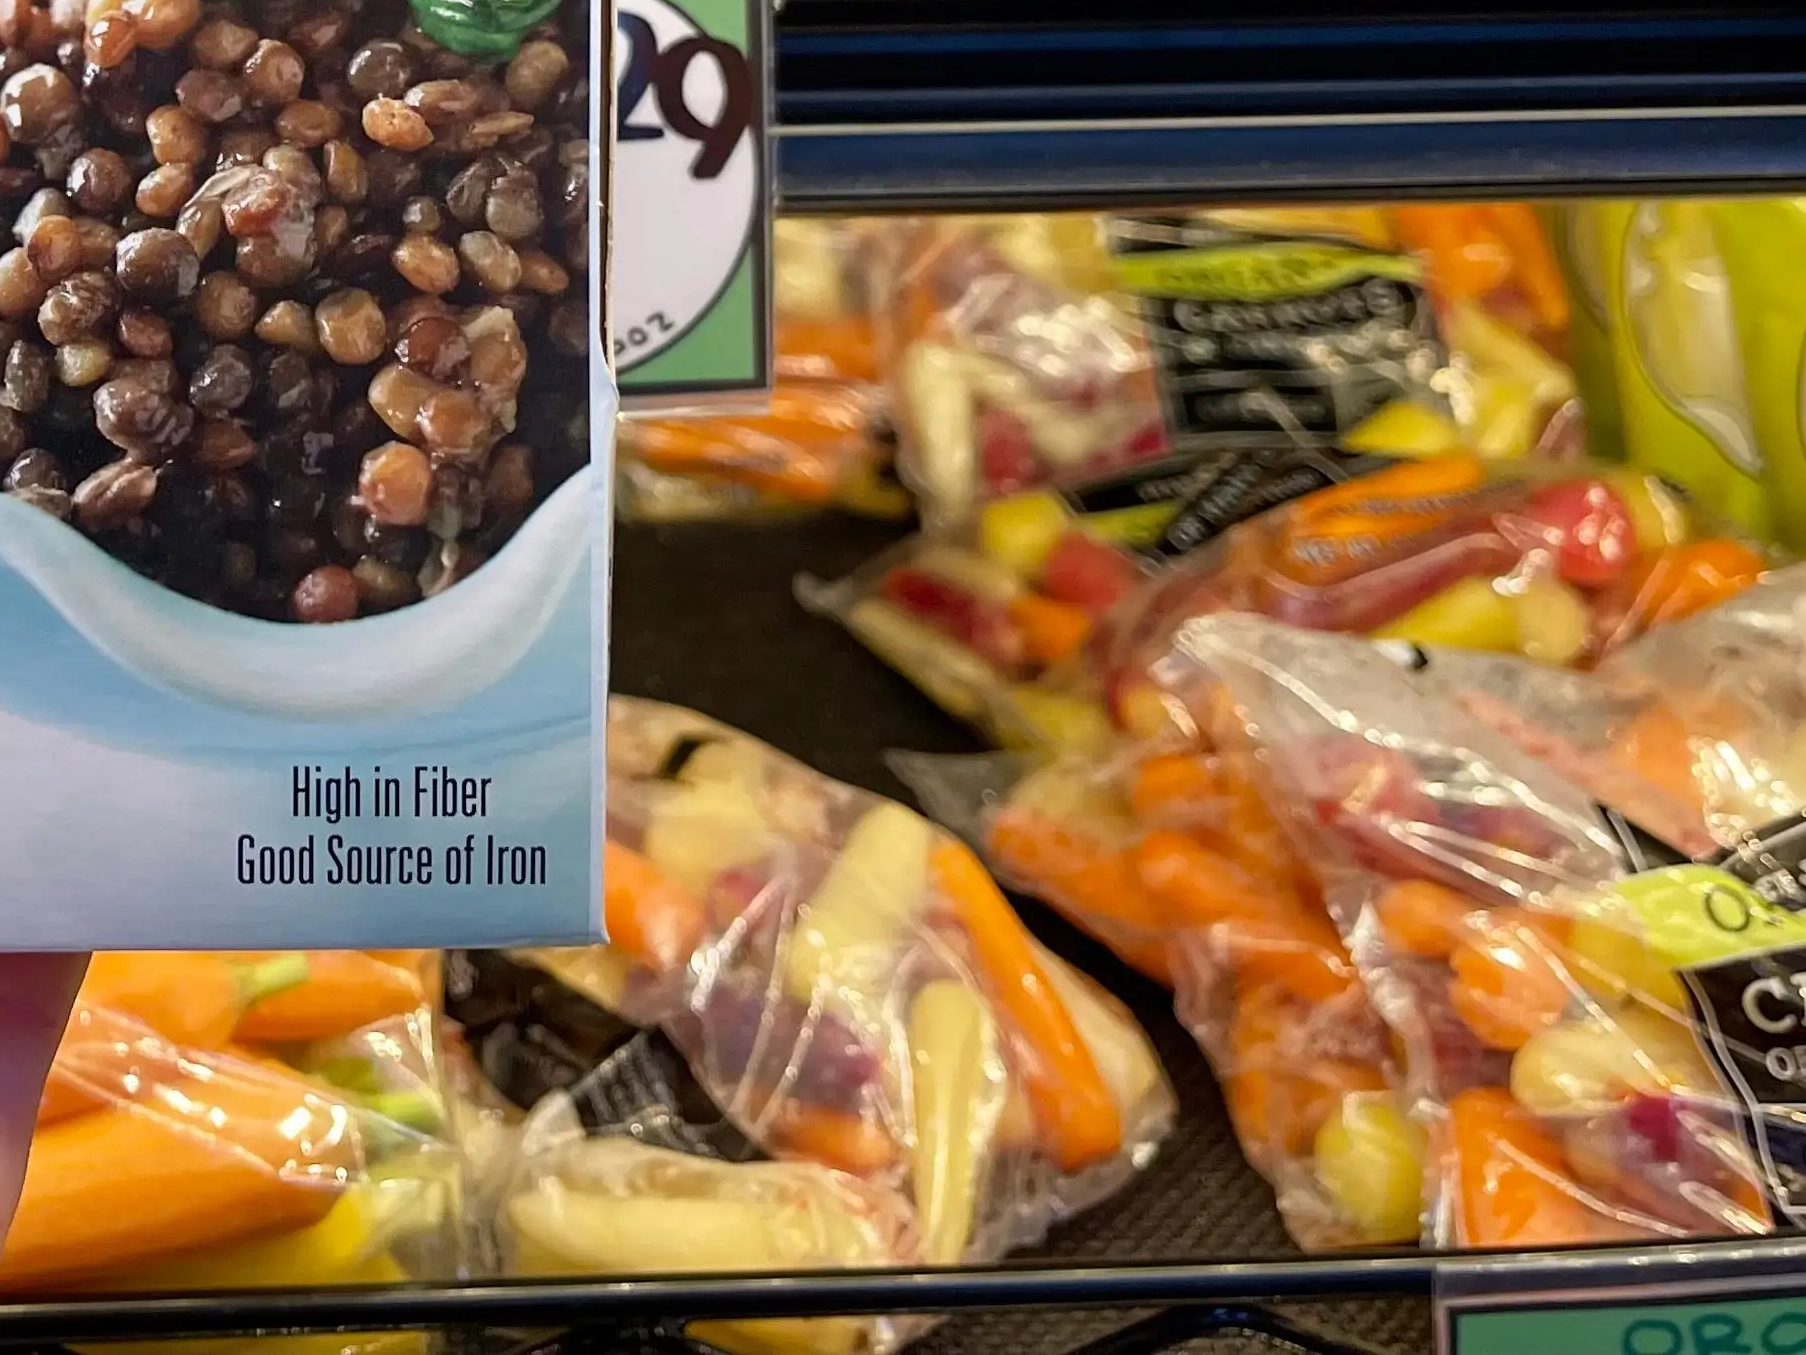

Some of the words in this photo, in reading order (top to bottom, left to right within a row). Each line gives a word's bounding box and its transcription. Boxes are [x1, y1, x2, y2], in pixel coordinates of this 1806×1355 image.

[292, 766, 361, 824] High
[374, 766, 401, 817] in
[414, 766, 492, 817] Fiber
[237, 834, 315, 885] Good
[327, 834, 433, 885] Source
[446, 834, 475, 885] of
[487, 834, 547, 885] Iron
